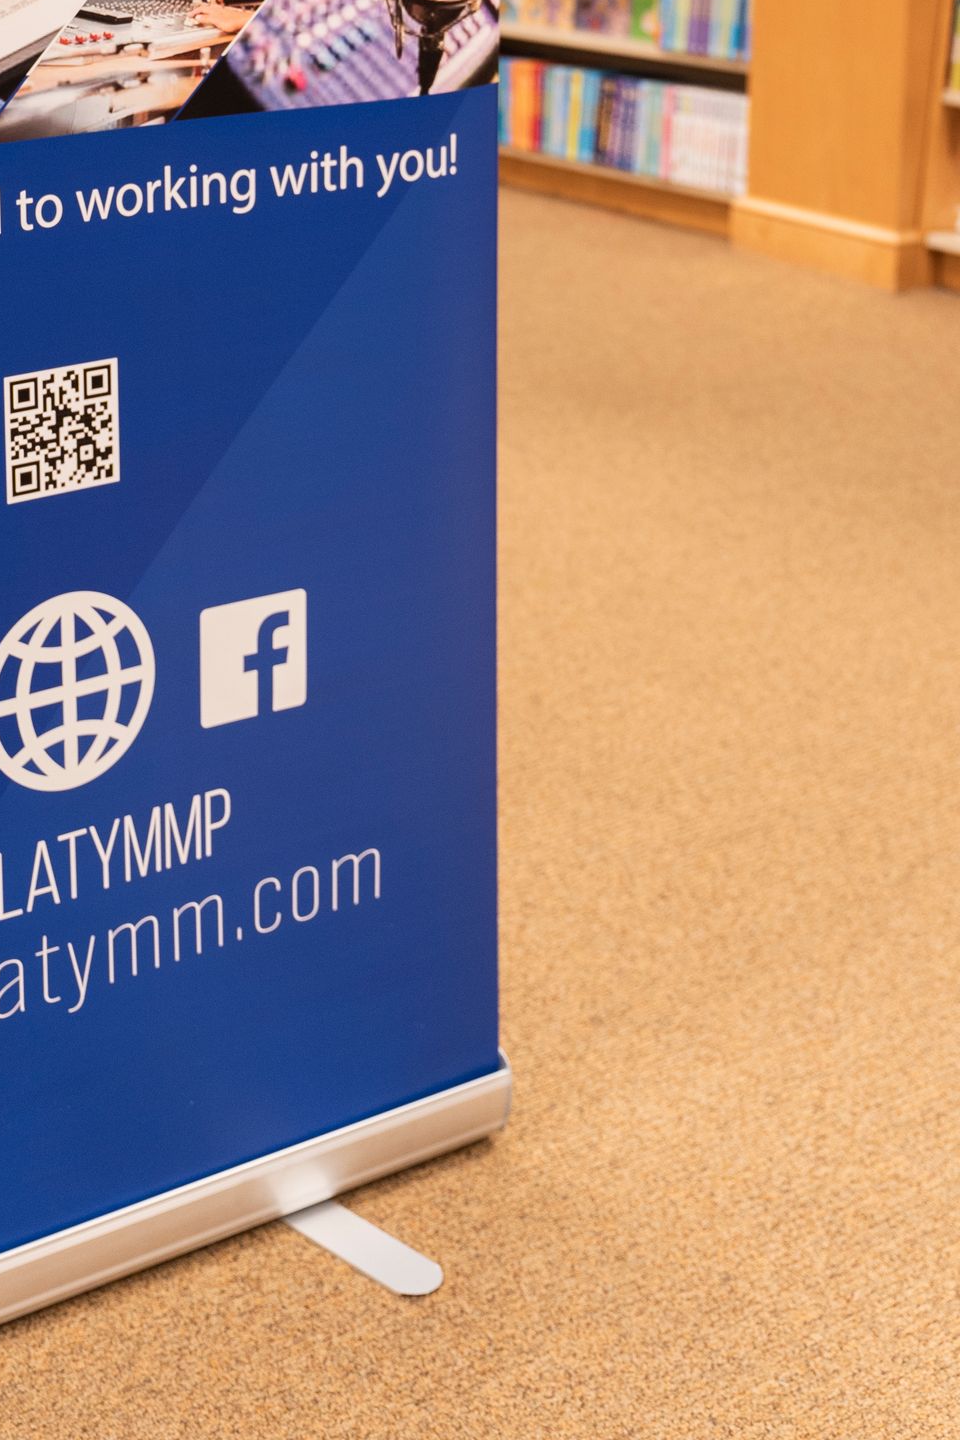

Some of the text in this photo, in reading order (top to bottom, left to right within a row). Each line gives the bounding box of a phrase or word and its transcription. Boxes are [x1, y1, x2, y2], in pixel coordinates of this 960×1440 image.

[15, 189, 64, 232] to
[75, 164, 256, 223] working
[269, 145, 364, 197] with
[375, 133, 458, 198] you!
